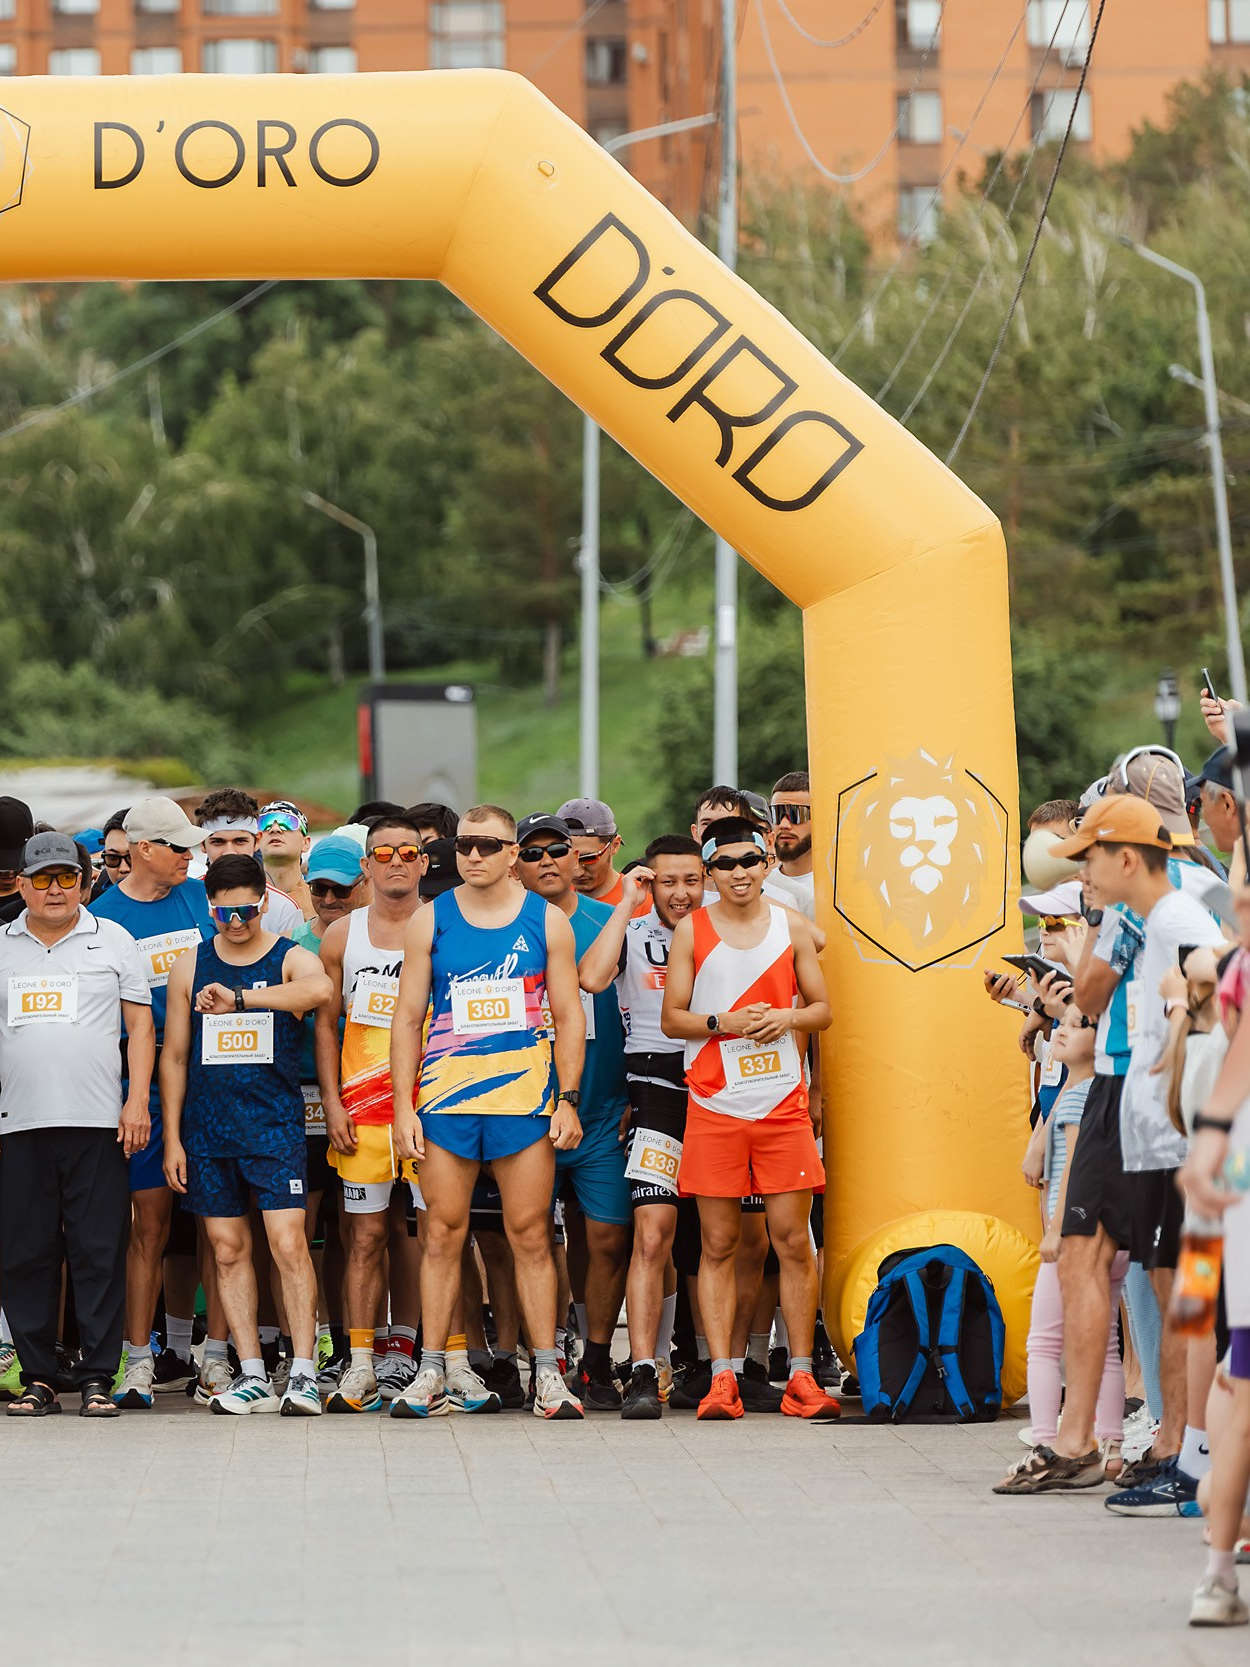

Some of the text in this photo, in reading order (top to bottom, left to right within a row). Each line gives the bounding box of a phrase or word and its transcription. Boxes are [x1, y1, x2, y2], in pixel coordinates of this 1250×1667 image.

[93, 118, 380, 190] D'ORO
[533, 212, 865, 512] D'ORO
[139, 941, 163, 952] LEONE
[156, 950, 185, 971] 19
[13, 981, 38, 989] LEONE
[363, 980, 388, 989] LEONE
[457, 987, 483, 996] LEONE
[25, 993, 58, 1010] 192
[372, 995, 396, 1014] 32
[471, 1000, 506, 1019] 360
[208, 1019, 233, 1027] LEONE
[221, 1033, 254, 1050] 500
[727, 1043, 753, 1054] LEONE
[743, 1053, 776, 1075] 337
[304, 1104, 325, 1121] 34
[638, 1134, 662, 1146] LEONE
[644, 1150, 676, 1175] 338
[631, 1185, 672, 1200] mirates
